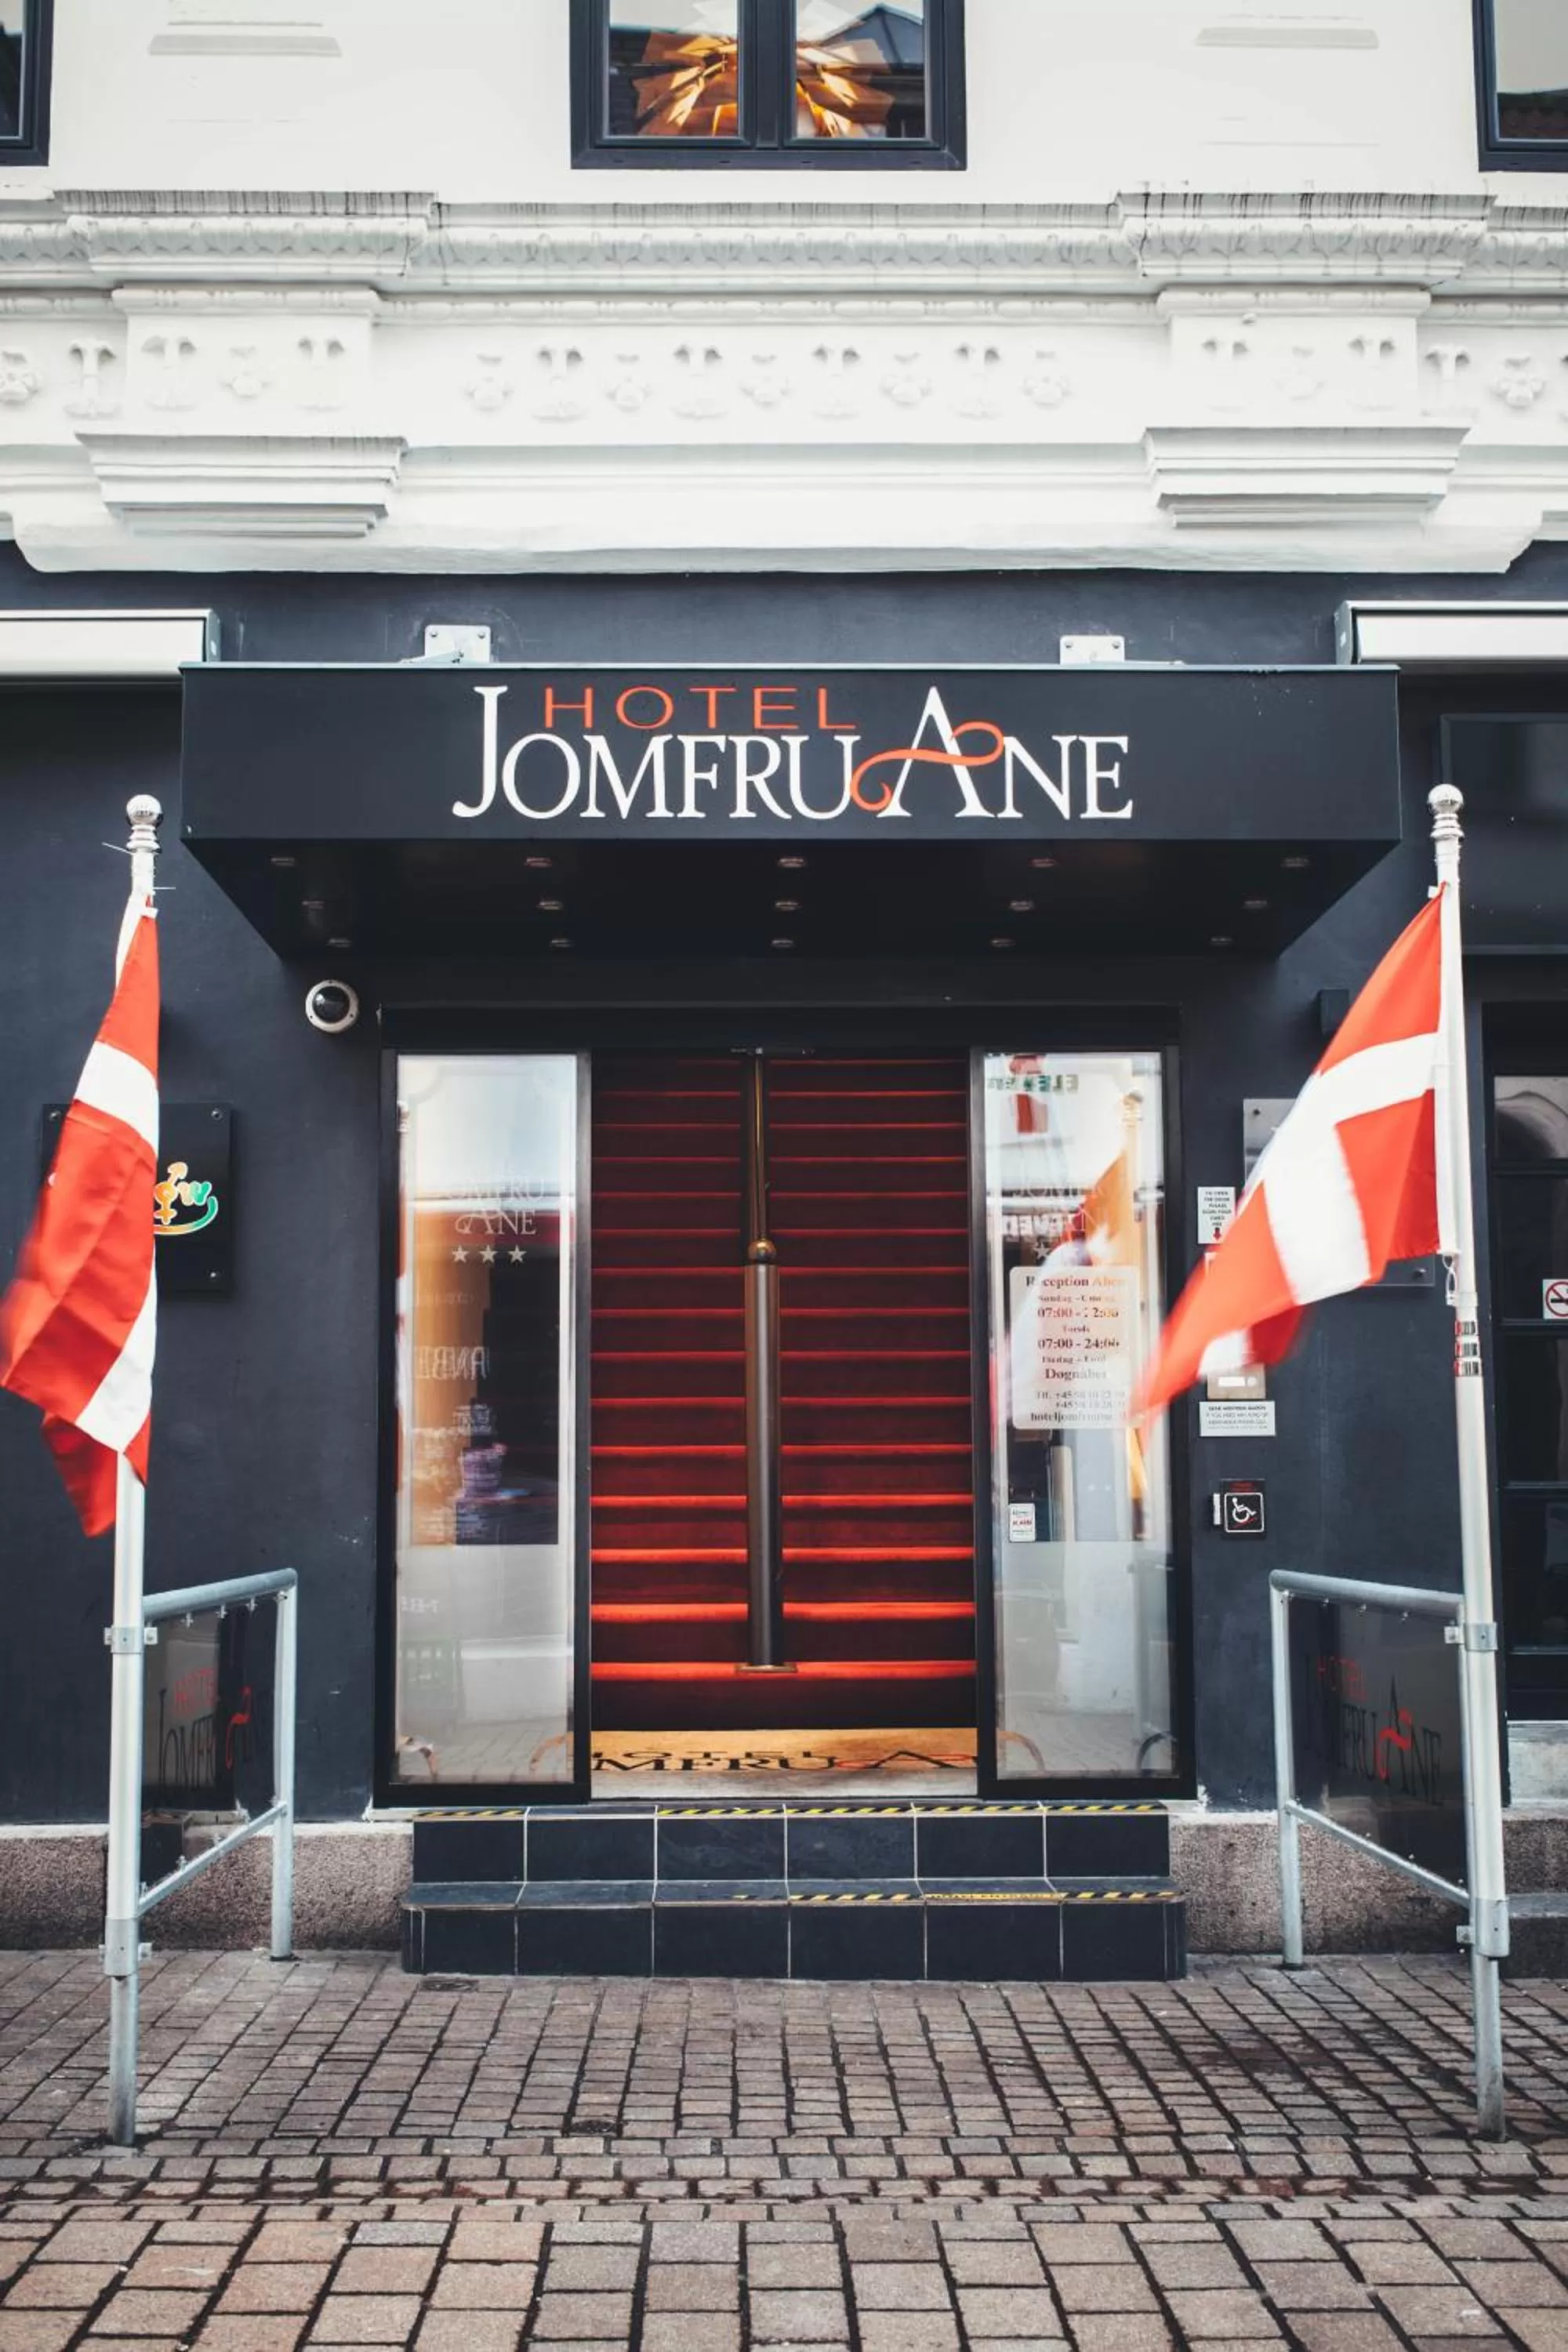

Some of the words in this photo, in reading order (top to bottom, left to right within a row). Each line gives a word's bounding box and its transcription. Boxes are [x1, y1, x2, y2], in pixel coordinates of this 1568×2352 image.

[544, 685, 857, 730] HOTEL
[1025, 1276, 1089, 1289] Rception
[1037, 1338, 1073, 1348] 07:00
[592, 1758, 839, 1772] MFRU
